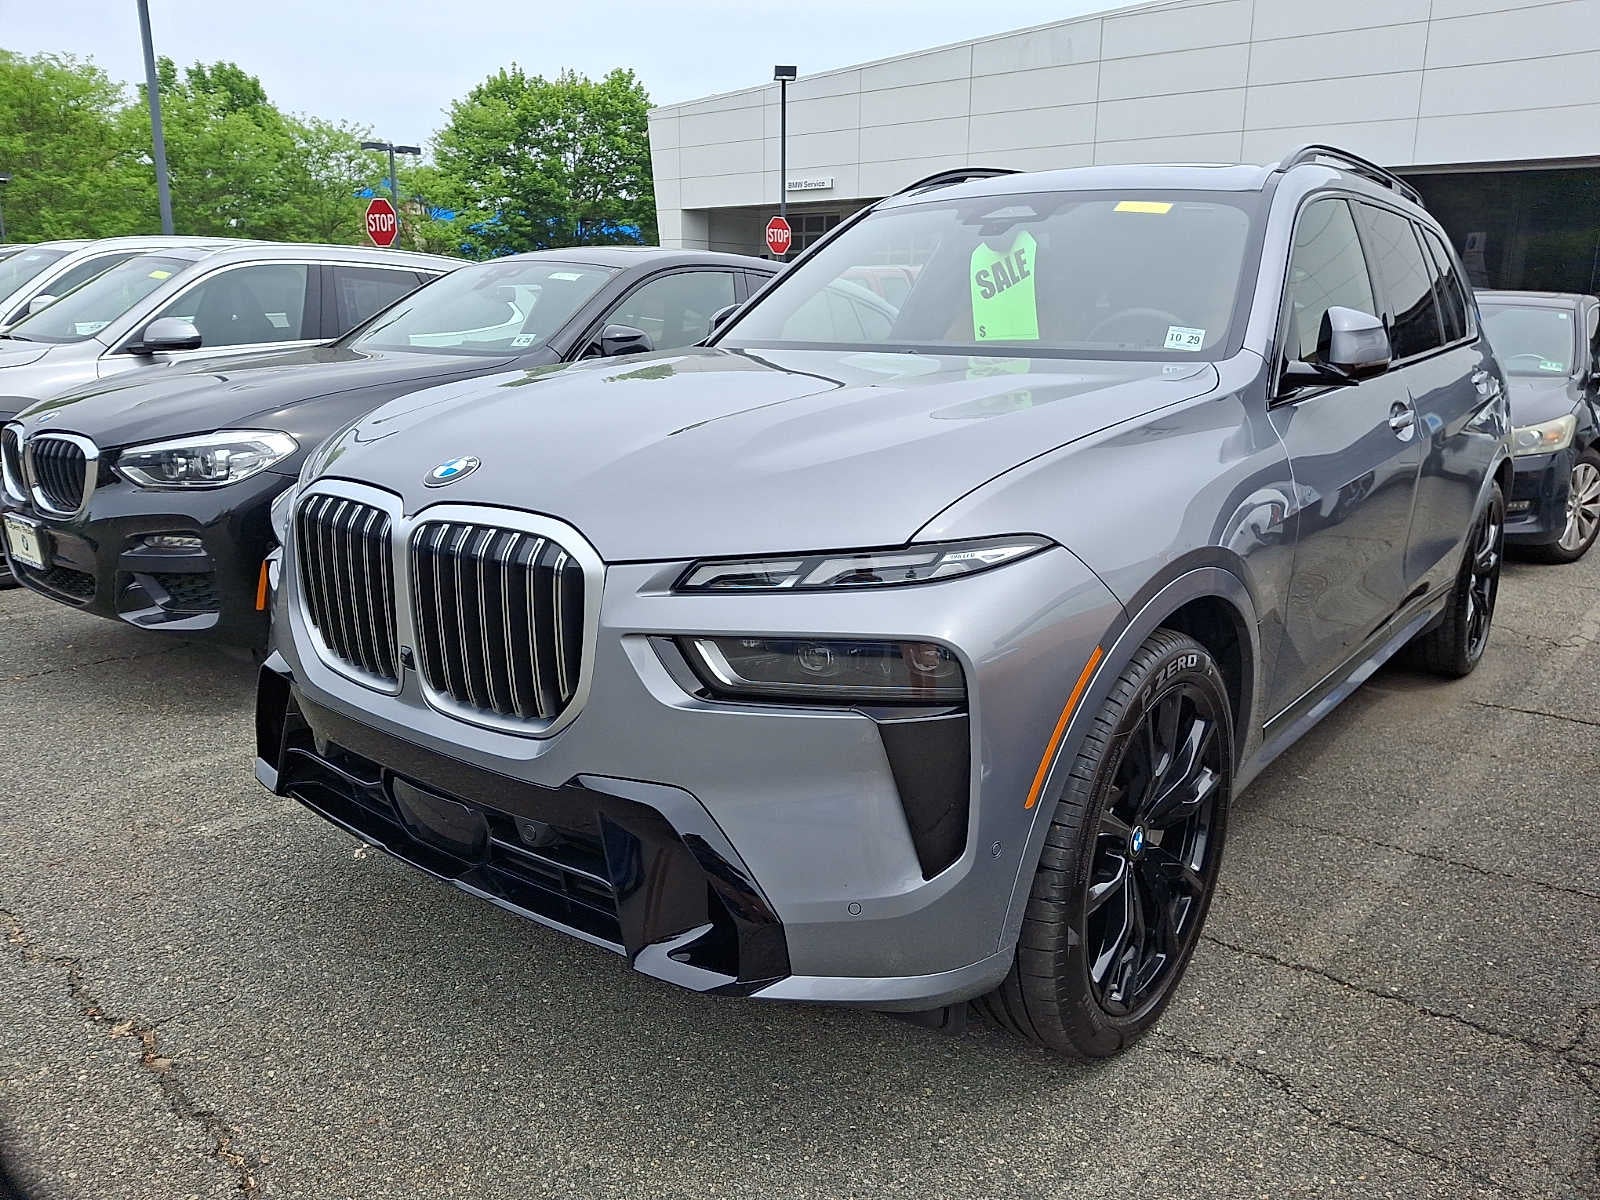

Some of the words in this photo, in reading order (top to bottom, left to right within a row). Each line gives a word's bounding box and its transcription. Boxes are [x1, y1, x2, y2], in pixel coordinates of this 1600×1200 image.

[787, 181, 803, 189] BMW
[803, 179, 826, 188] Service
[368, 213, 394, 232] STOP
[768, 228, 789, 243] STOP
[975, 248, 1031, 299] SALE
[979, 325, 987, 338] $
[1170, 333, 1182, 342] 10
[1186, 335, 1200, 345] 29
[1155, 654, 1198, 691] ZERO
